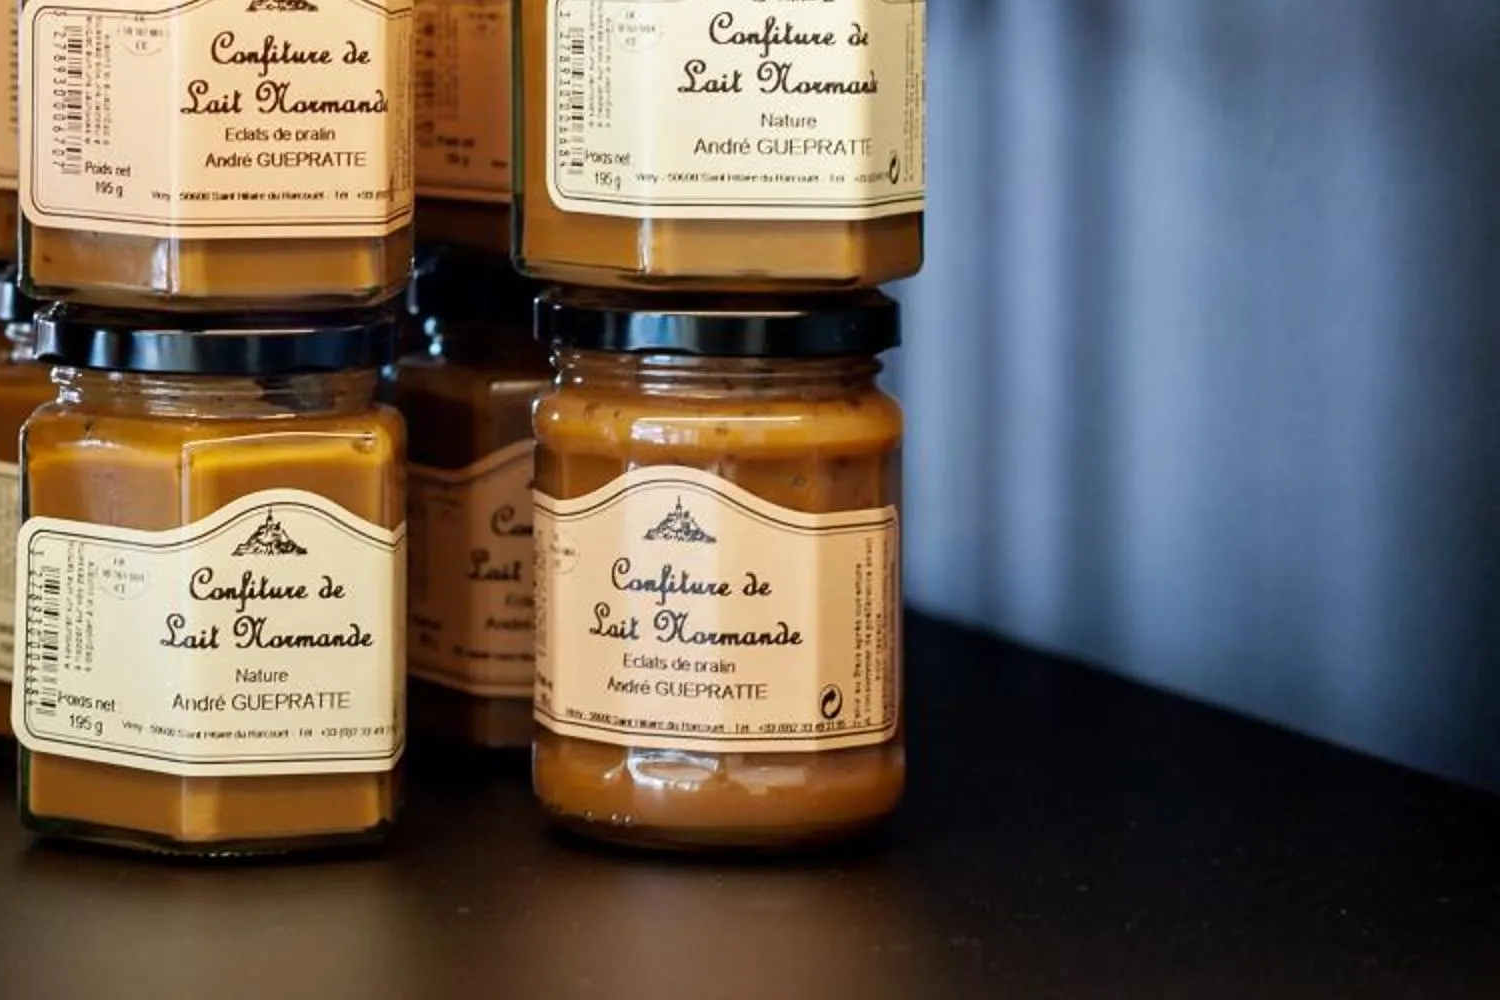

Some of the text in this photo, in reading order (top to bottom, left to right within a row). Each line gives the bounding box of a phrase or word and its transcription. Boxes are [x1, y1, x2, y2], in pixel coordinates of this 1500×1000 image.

[708, 11, 869, 58] Confiture de
[211, 30, 371, 77] Confiture de
[678, 59, 878, 95] Lait Normand
[180, 79, 243, 114] Lait
[761, 113, 817, 129] Nature
[225, 127, 269, 142] Eclats
[273, 127, 292, 142] de
[693, 137, 873, 156] André GUEPRATTE
[85, 161, 131, 177] Poids net
[205, 151, 367, 168] André GUEPRATTE
[595, 171, 621, 190] 195 g
[189, 566, 346, 613] Confiture de
[611, 557, 773, 606] Confiture de
[160, 613, 220, 649] Lait
[233, 615, 374, 649] Normande
[589, 602, 803, 645] Lait Normande
[623, 653, 668, 670] Eclats
[672, 657, 691, 671] de
[235, 668, 289, 683] Nature
[607, 676, 769, 700] André GUEPRATTE
[96, 699, 116, 712] net
[172, 691, 351, 711] André GUEPRATTE
[69, 714, 104, 736] 195 g
